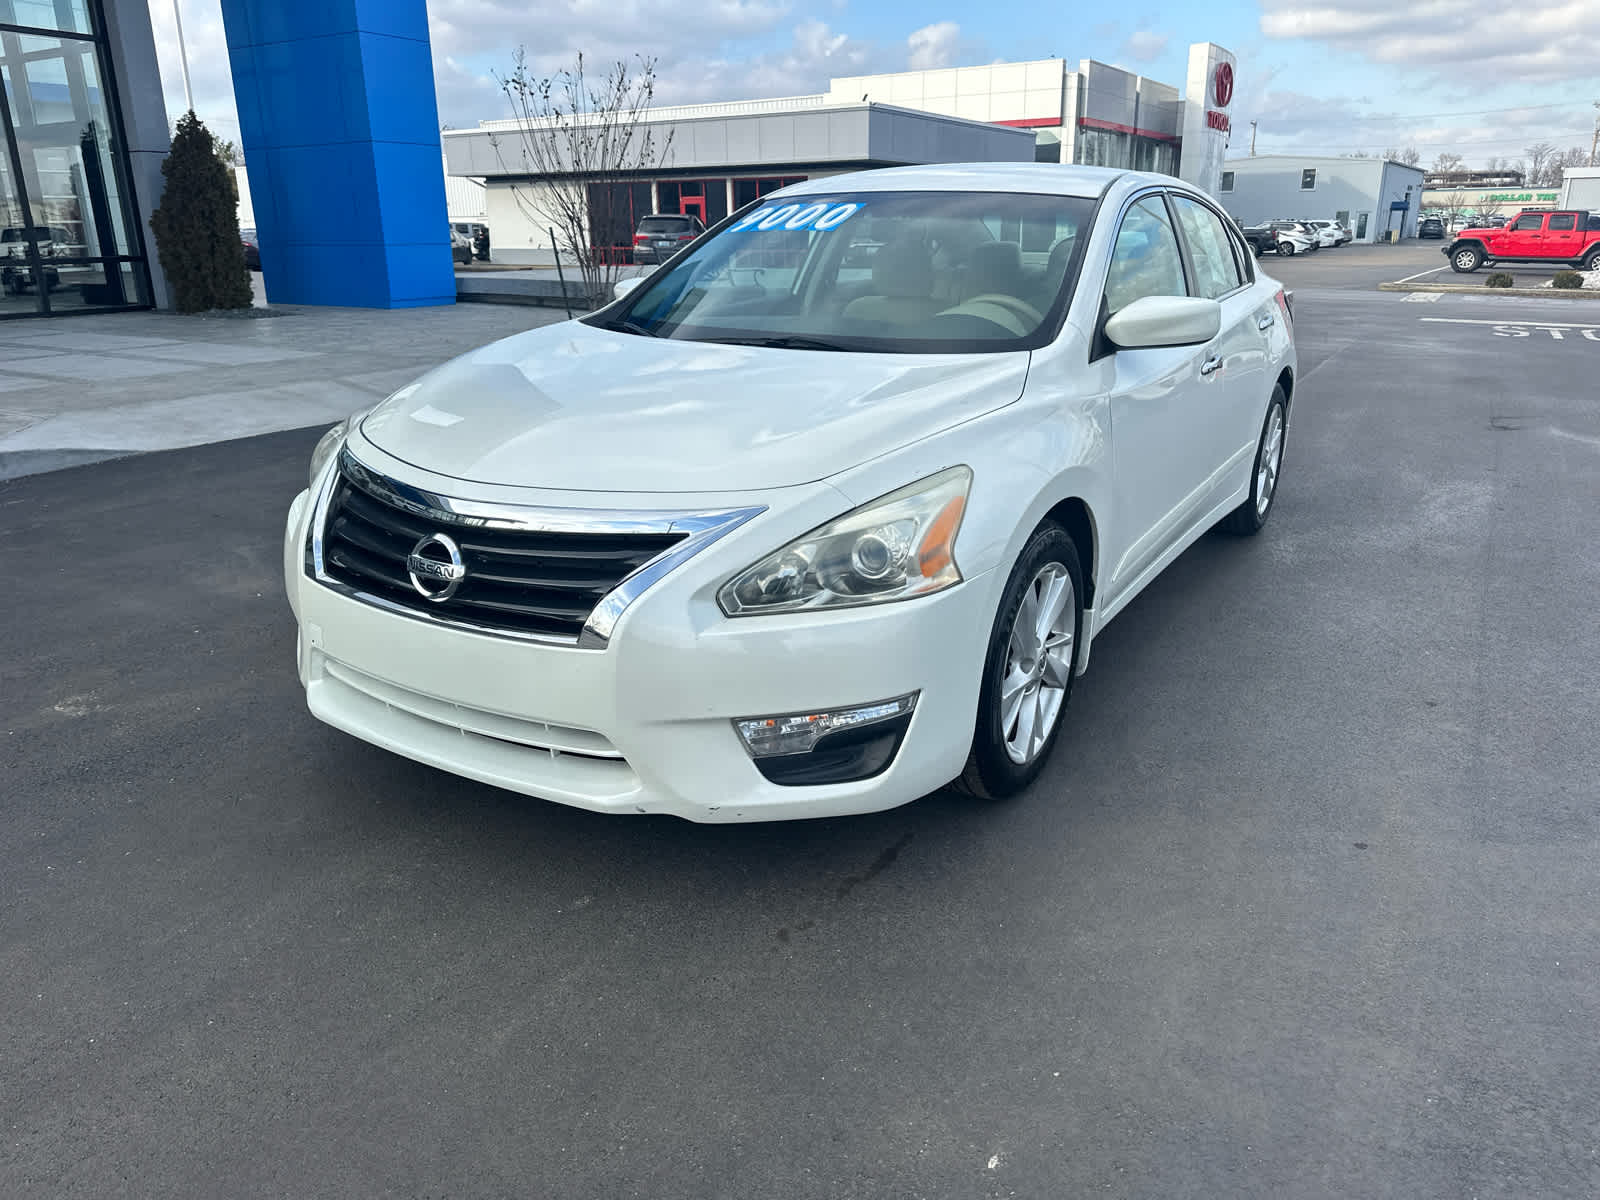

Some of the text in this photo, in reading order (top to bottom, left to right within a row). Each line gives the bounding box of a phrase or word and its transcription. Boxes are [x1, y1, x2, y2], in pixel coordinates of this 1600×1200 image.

[1490, 193, 1533, 202] DOLLAR
[730, 203, 857, 232] 9000
[408, 557, 455, 578] NISSAN
